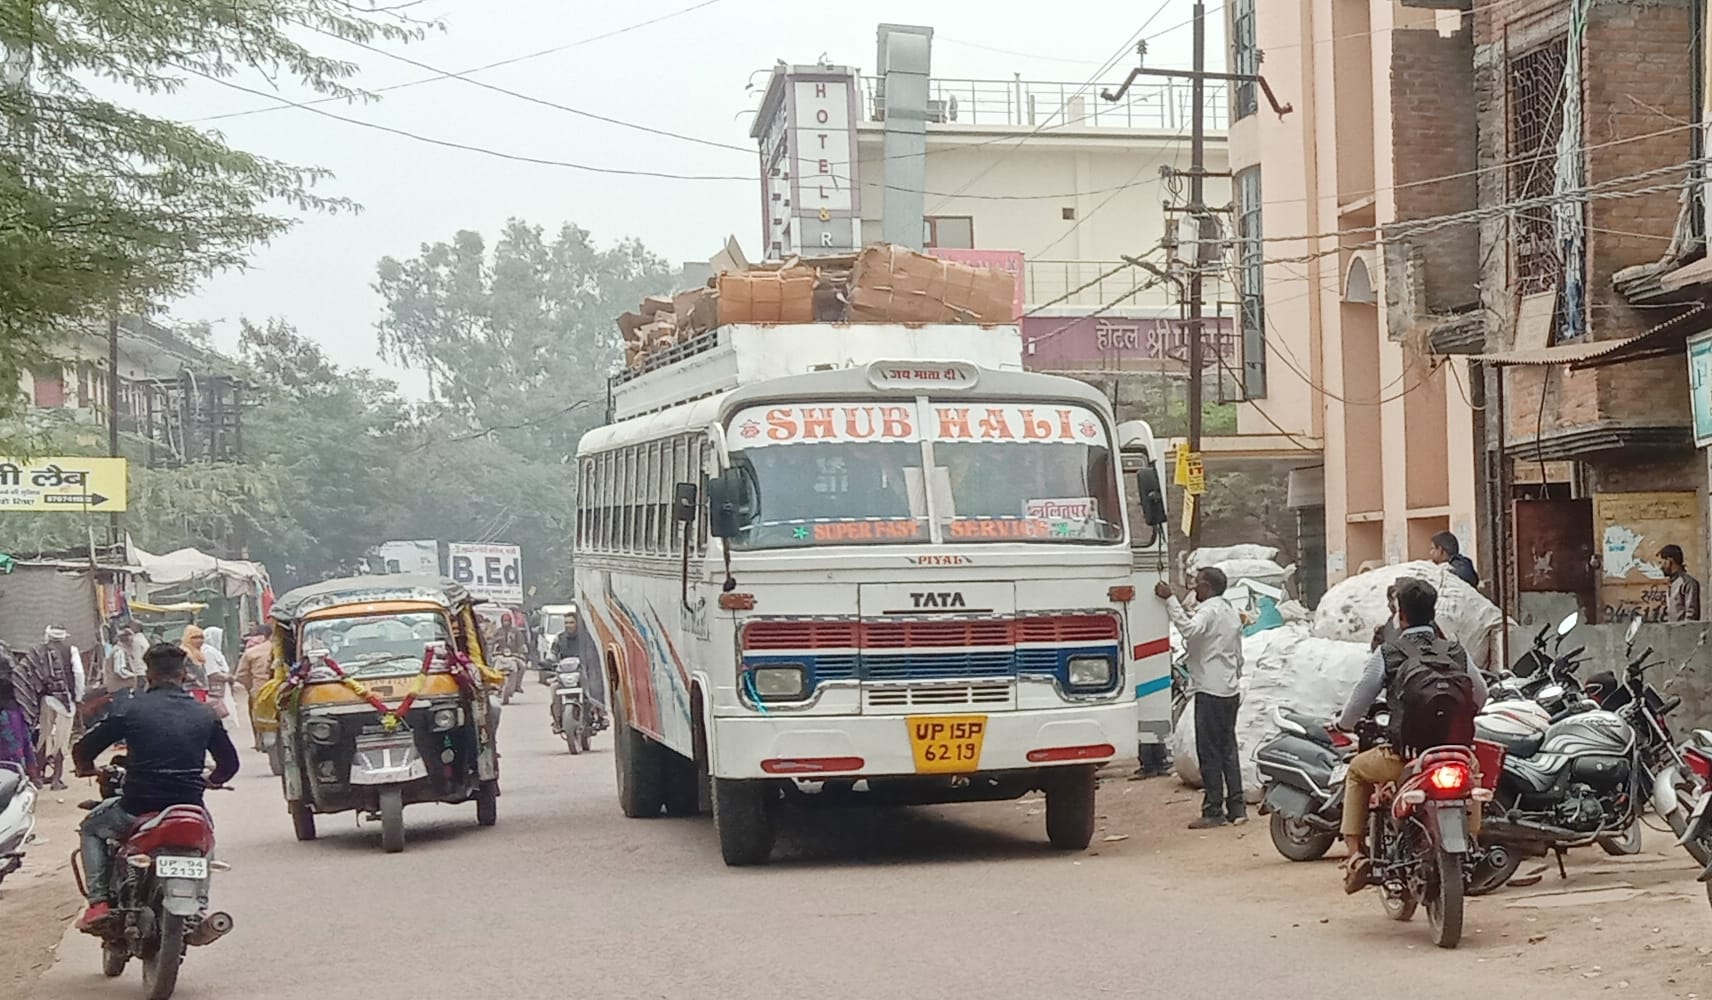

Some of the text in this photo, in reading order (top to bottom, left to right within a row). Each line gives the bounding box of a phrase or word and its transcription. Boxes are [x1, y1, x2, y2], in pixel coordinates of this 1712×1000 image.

[816, 83, 829, 200] HOTEL
[818, 207, 832, 222] &
[1096, 319, 1139, 350] होटल
[889, 368, 956, 381] जय माता दी
[766, 406, 1076, 440] SHUB HALI
[30, 464, 89, 487] लैब
[814, 523, 873, 539] SUPER
[875, 521, 920, 537] FAST
[950, 519, 1048, 537] SERVICE
[453, 555, 519, 584] B.Ed
[917, 555, 963, 566] PIYAL
[910, 592, 966, 607] TATA
[916, 722, 983, 741] UP 15P
[925, 743, 976, 761] 6219
[160, 867, 204, 877] L2137
[186, 860, 203, 868] 94
